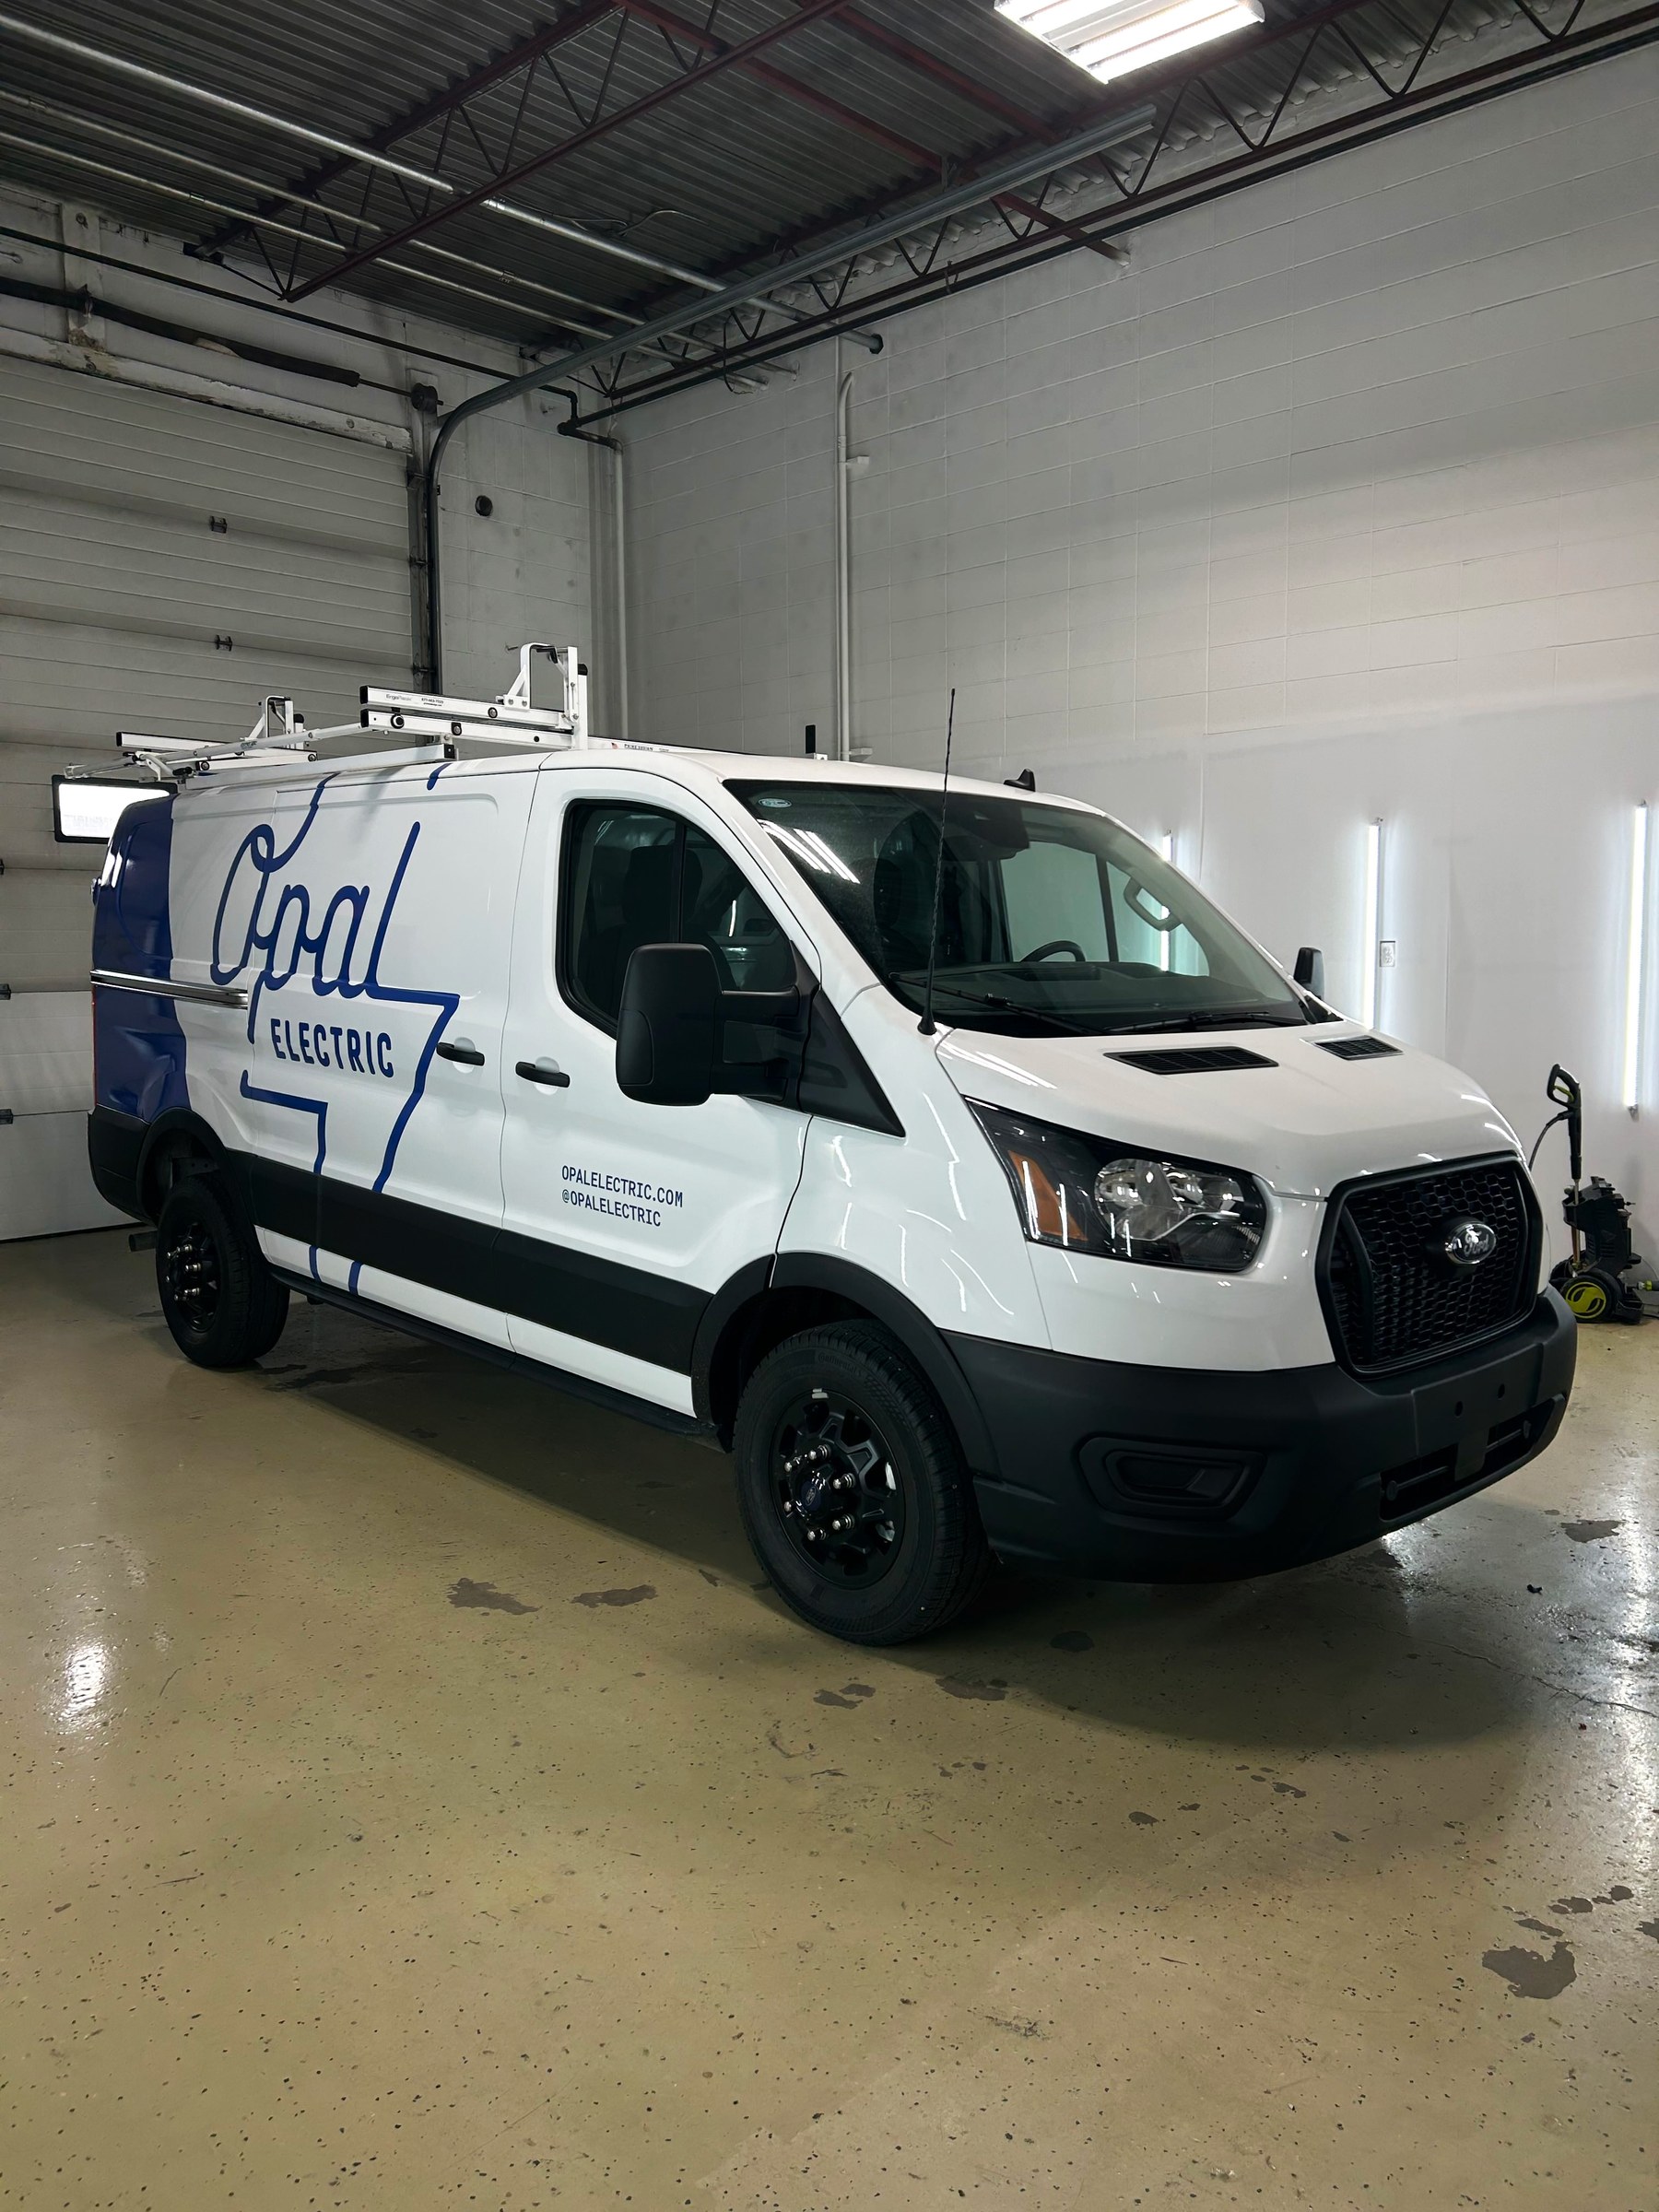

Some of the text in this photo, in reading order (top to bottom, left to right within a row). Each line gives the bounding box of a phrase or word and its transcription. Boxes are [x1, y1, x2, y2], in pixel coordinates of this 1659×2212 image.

[210, 821, 421, 1044] Opal
[270, 1018, 395, 1078] ELECTRIC
[561, 1164, 684, 1208] OPALELECTRIC.COM
[561, 1189, 662, 1228] @OPALELECTRIC
